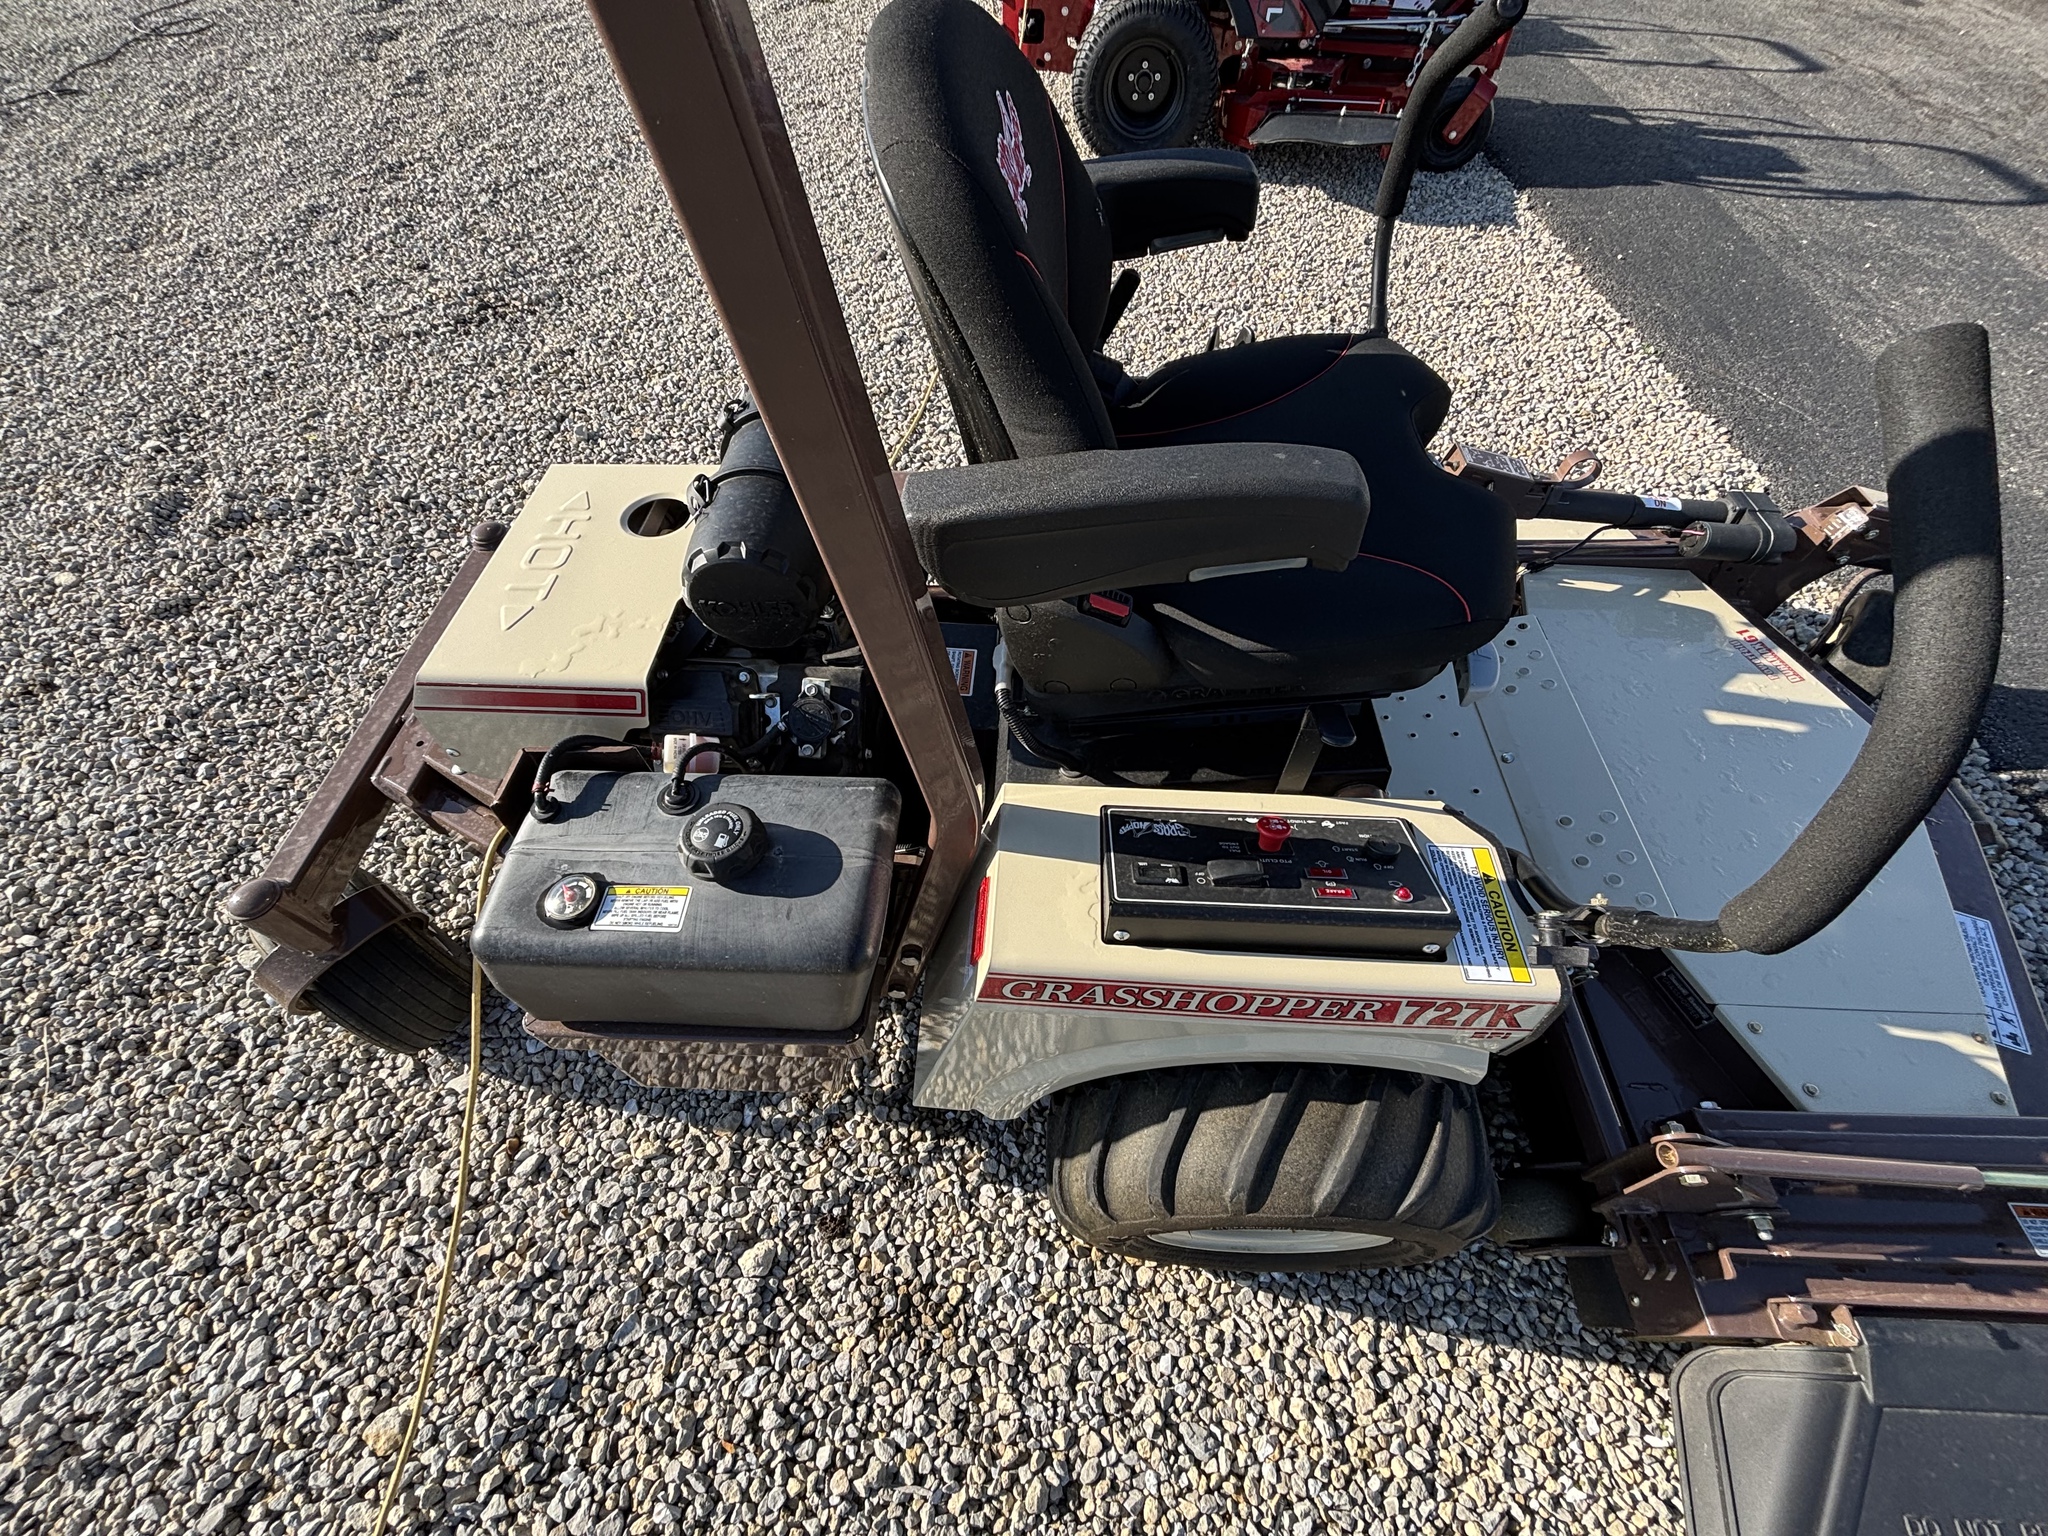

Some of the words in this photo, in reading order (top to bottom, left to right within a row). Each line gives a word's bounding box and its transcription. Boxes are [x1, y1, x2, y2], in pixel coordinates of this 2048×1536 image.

[504, 515, 591, 601] HOT
[1735, 629, 1759, 645] 61
[960, 660, 971, 691] WARNING
[671, 710, 711, 727] OHV
[1469, 865, 1478, 875] TO
[1472, 876, 1485, 897] AVOID
[1480, 899, 1496, 931] SERIOUS
[1487, 890, 1518, 951] CAUTION
[1490, 933, 1505, 960] INJURY
[1000, 980, 1384, 1021] GRASSHOPPER
[1403, 1000, 1536, 1028] 727K
